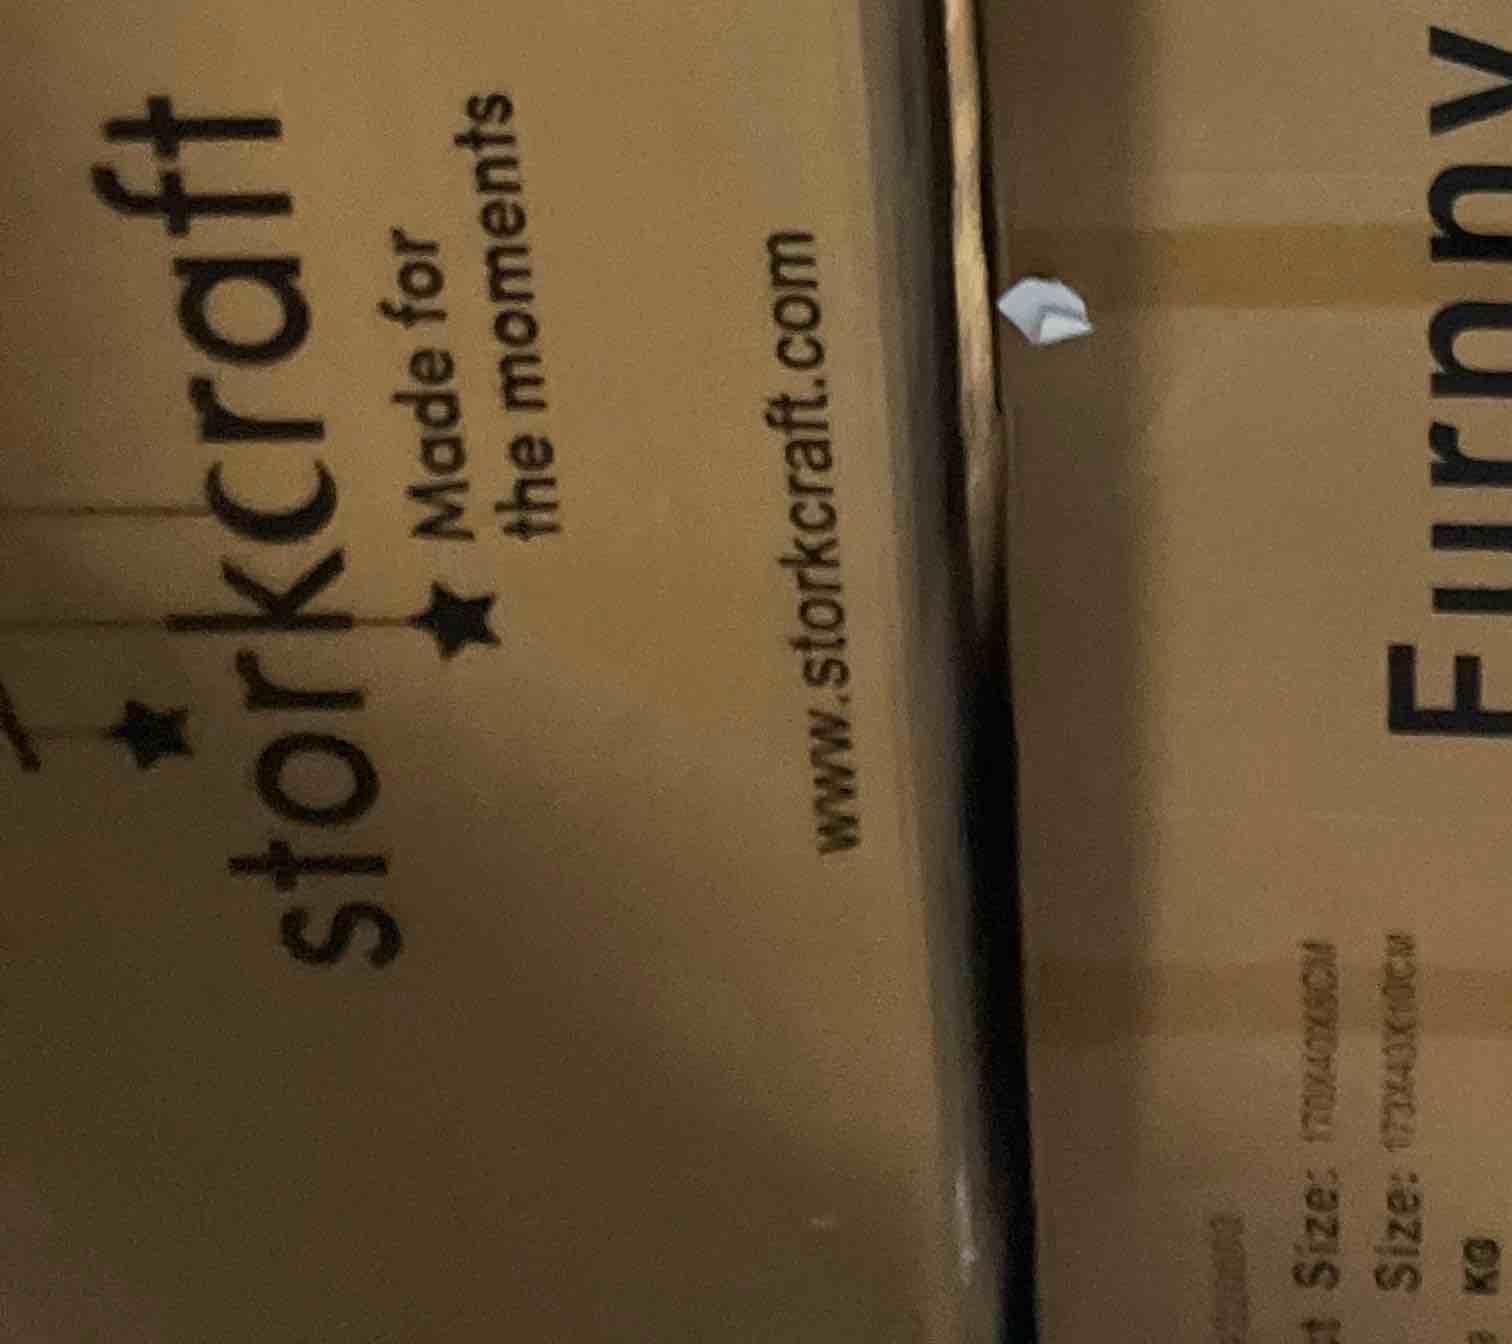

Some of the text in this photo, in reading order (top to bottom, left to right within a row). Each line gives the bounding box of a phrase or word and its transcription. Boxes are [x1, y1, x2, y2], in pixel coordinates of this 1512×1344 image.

[376, 225, 476, 543] Made for
[454, 90, 562, 544] the moments
[91, 92, 402, 970] storkcraft
[765, 229, 861, 856] www.storkcraft.com
[1292, 1166, 1342, 1293] Size:
[1374, 1171, 1423, 1294] Size:
